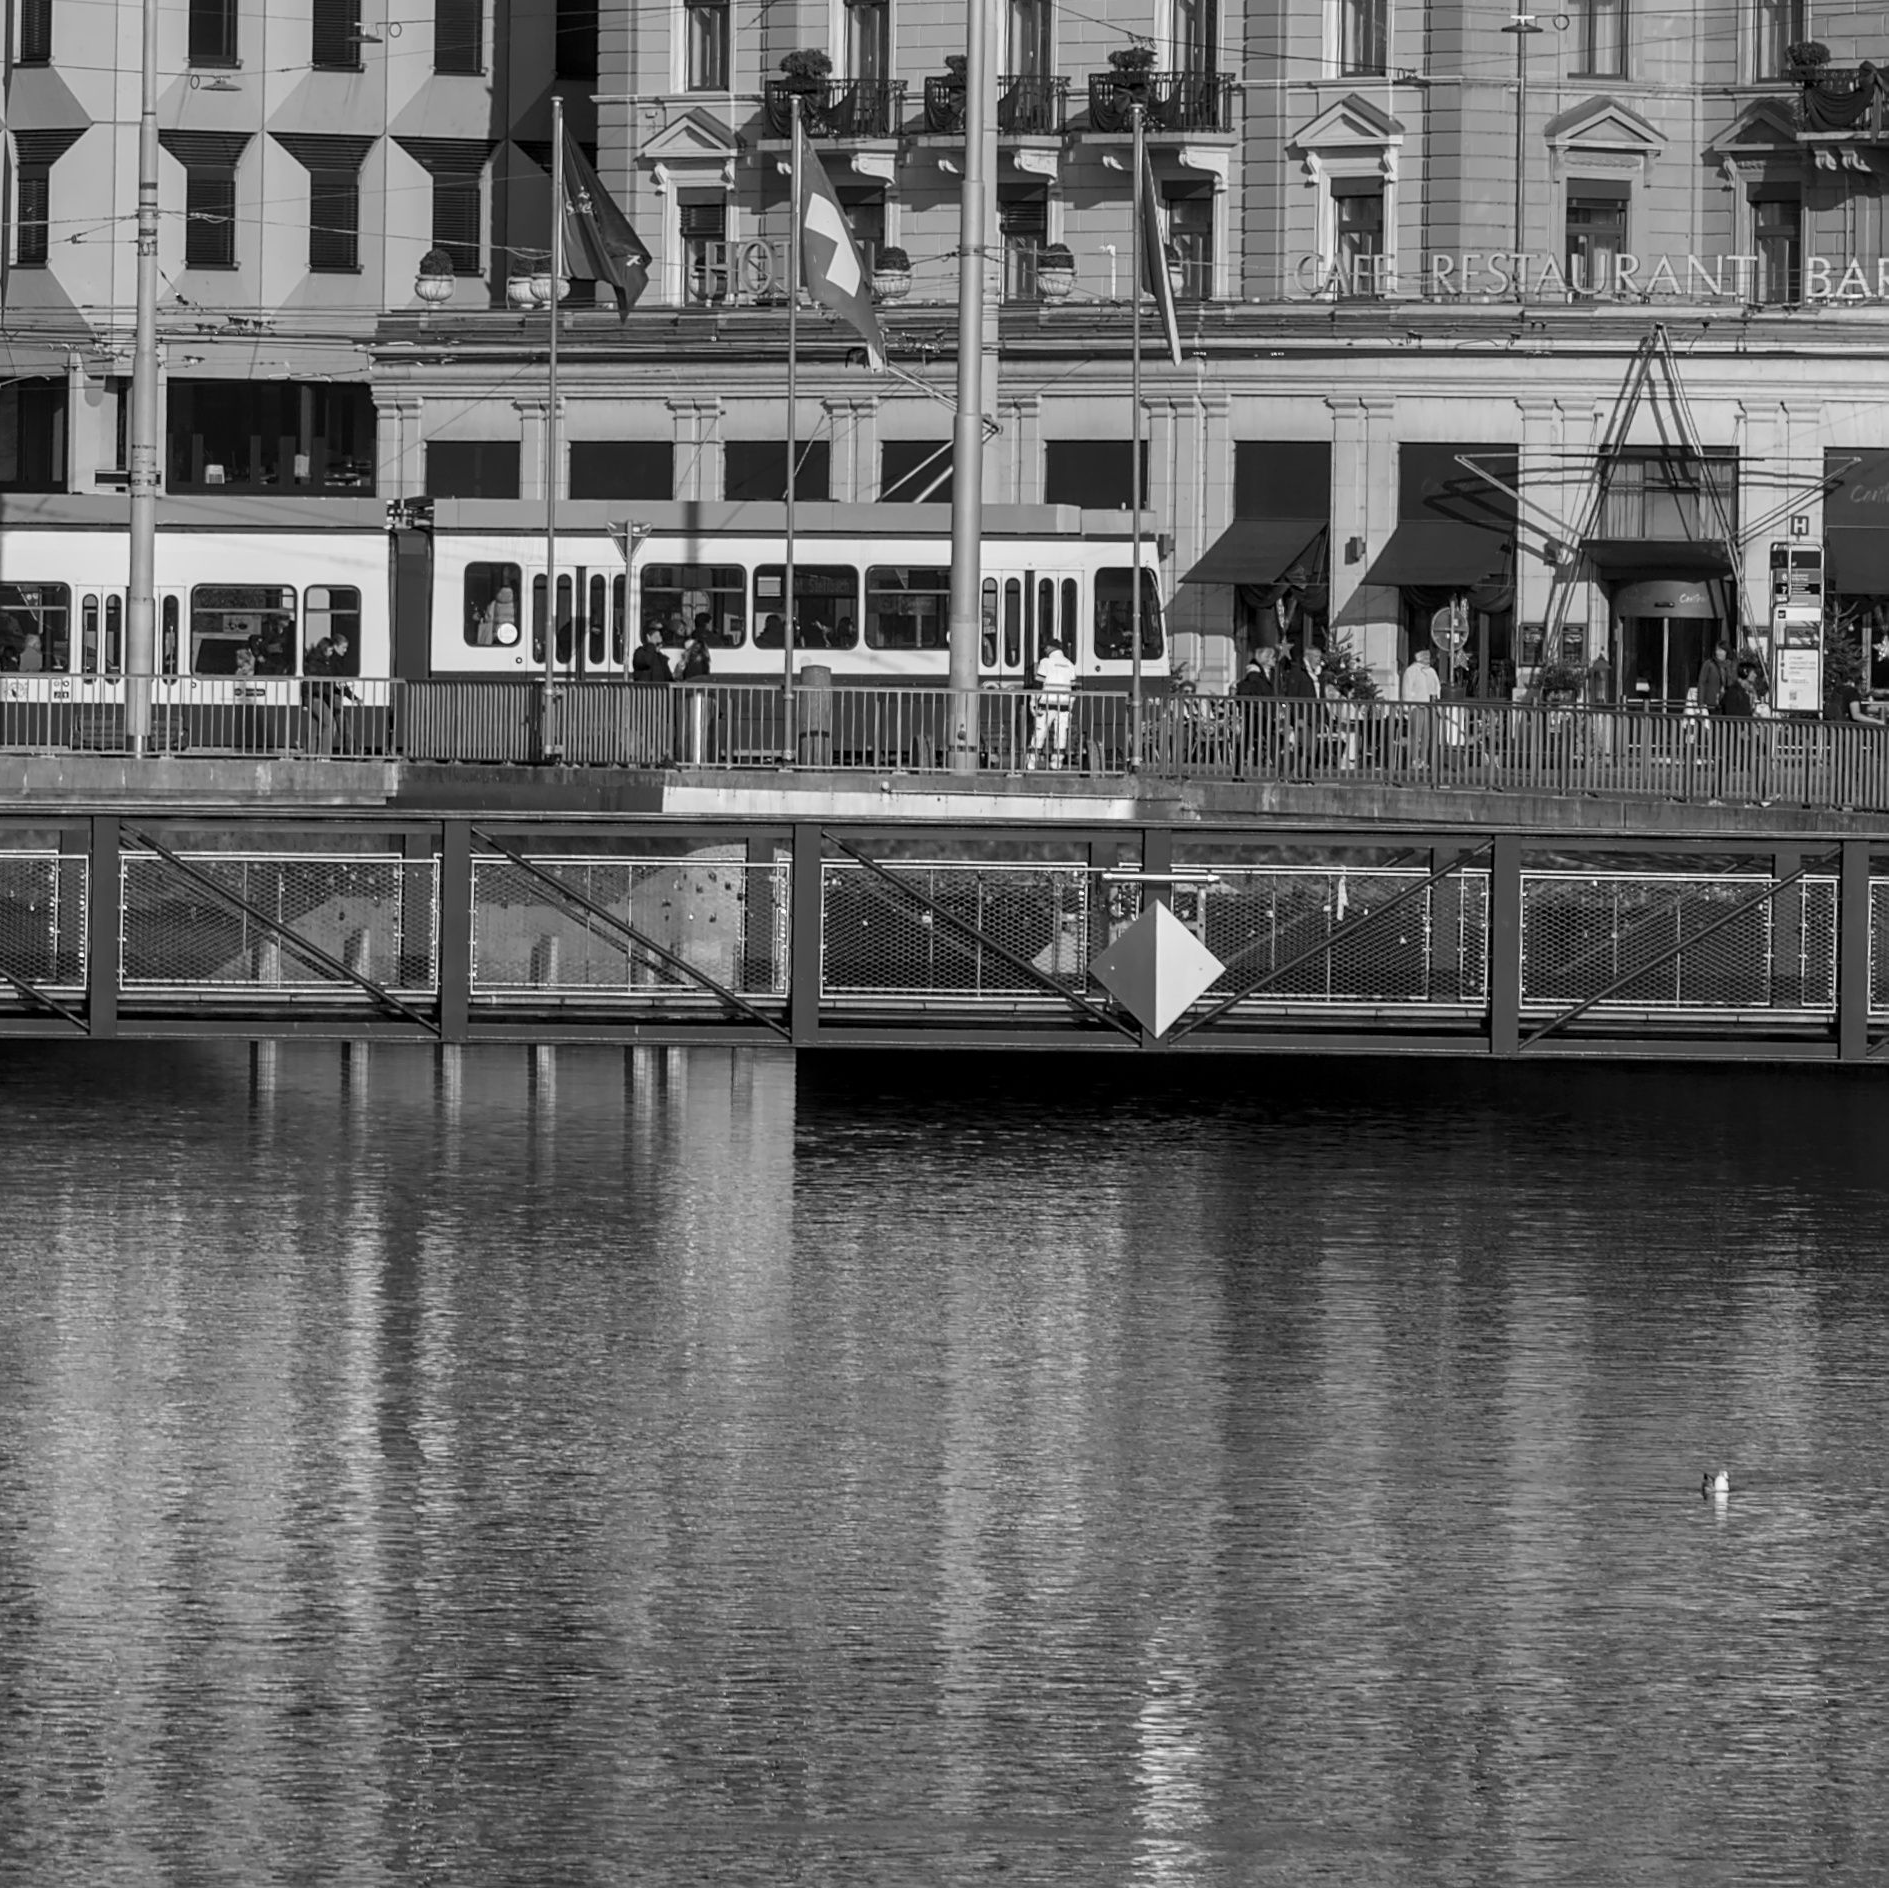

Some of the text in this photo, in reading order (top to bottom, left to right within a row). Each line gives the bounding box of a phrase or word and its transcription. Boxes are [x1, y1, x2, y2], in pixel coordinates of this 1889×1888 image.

[705, 238, 792, 295] HOT
[1432, 253, 1758, 296] RESTAURANT
[1793, 517, 1807, 534] H
